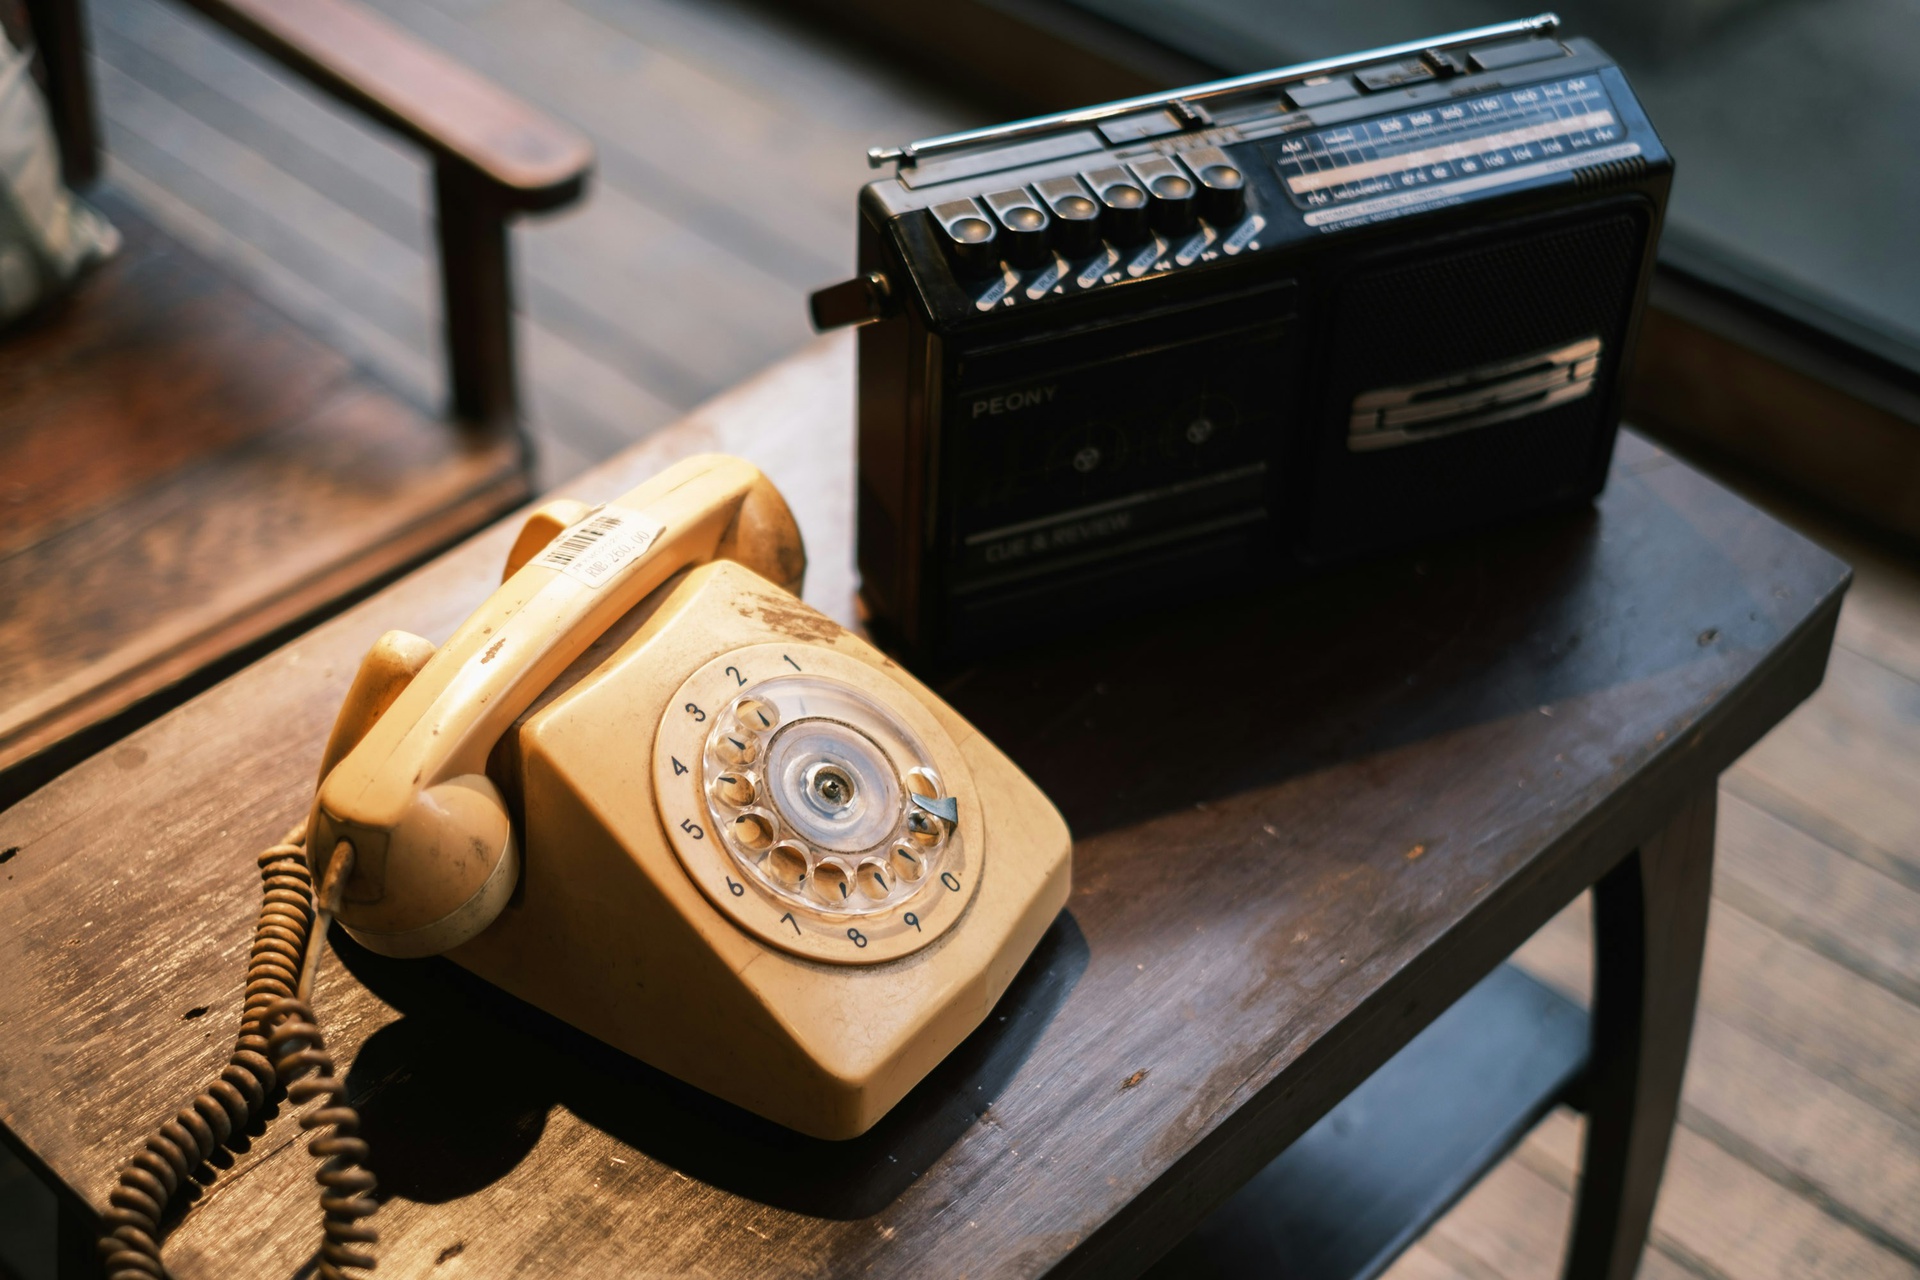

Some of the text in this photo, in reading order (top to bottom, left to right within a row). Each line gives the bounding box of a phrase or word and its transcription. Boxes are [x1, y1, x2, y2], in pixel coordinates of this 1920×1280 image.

[1281, 140, 1302, 153] AM
[1567, 80, 1588, 92] AM
[1307, 192, 1328, 206] FM
[1594, 128, 1615, 142] FM
[1039, 270, 1058, 289] PLAY
[971, 384, 1059, 419] PEONY
[985, 511, 1134, 563] CUE & REVIEW
[783, 654, 802, 672] 1
[725, 666, 748, 687] 2
[685, 702, 706, 723] 3
[670, 756, 689, 776] 4
[680, 818, 704, 840] 5
[725, 875, 745, 897] 6
[940, 873, 959, 892] 0
[780, 912, 803, 936] 7
[903, 912, 922, 932] 9
[846, 928, 868, 949] 8
